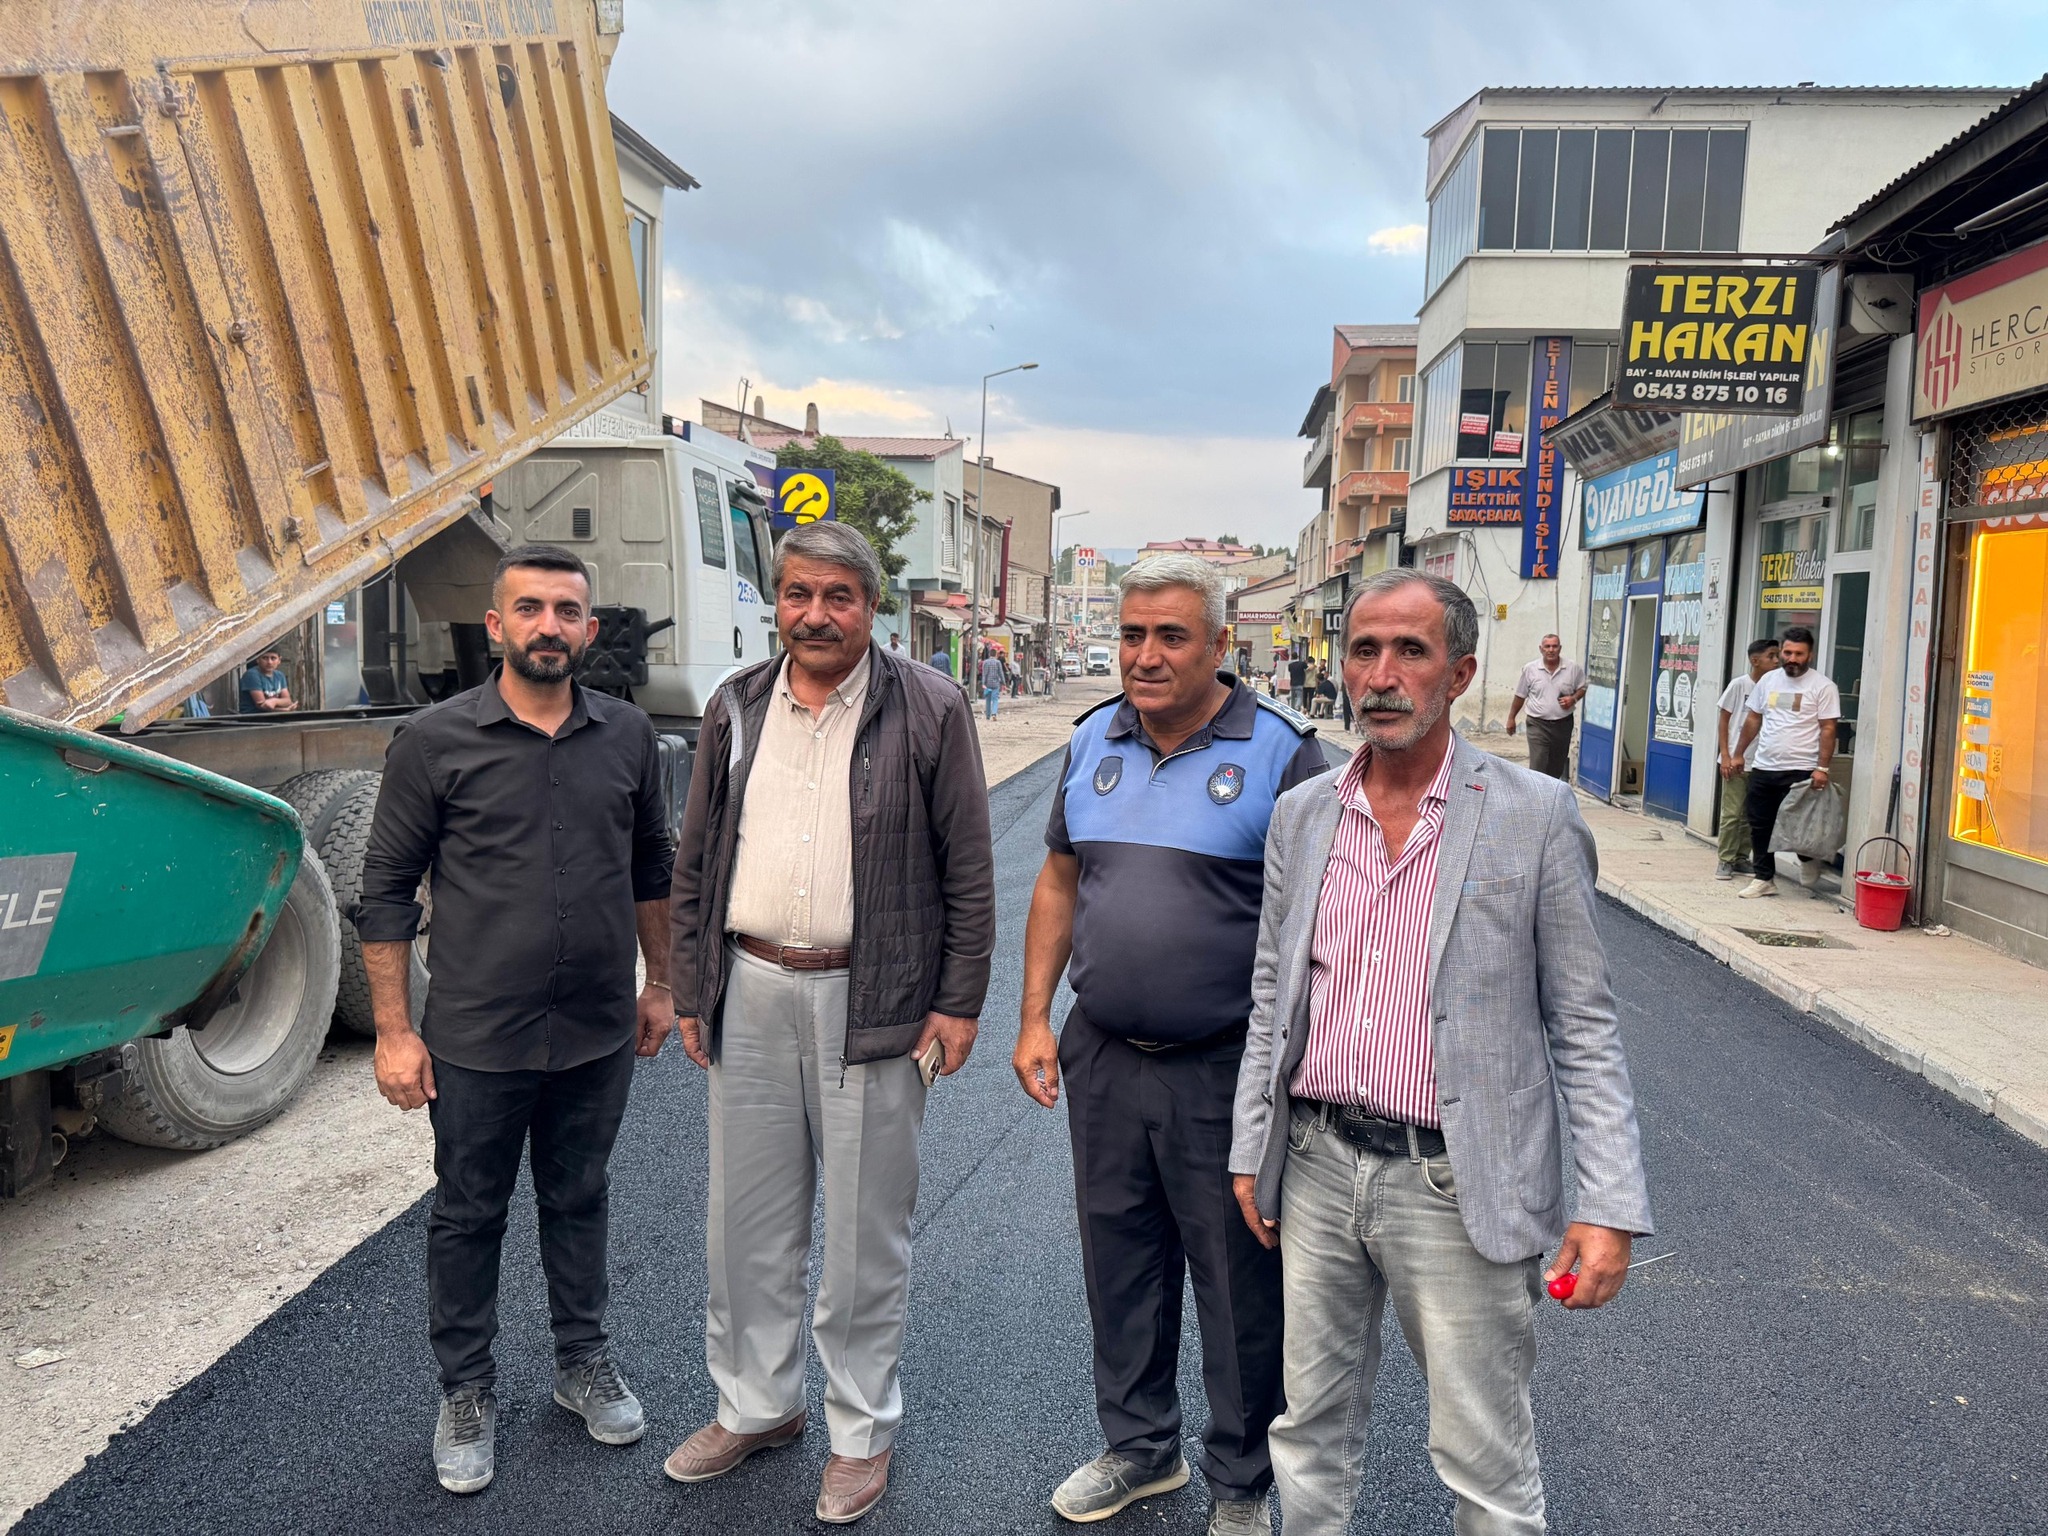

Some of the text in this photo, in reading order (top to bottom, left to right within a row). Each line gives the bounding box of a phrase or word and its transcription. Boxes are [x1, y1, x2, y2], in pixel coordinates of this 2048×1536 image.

[1628, 320, 1807, 366] HAKAN
[1625, 368, 1647, 378] BAY
[1655, 369, 1690, 379] BAYAN
[1692, 369, 1722, 380] DİKİM
[1723, 370, 1757, 382] İŞLERİ
[1759, 372, 1800, 383] YAPILIR
[1633, 382, 1788, 404] 0543 875 10 16
[1455, 469, 1521, 491] IŞIK
[1452, 490, 1521, 506] ELEKTRİK
[1448, 509, 1522, 525] SAYAÇBARA
[0, 887, 62, 931] LE
